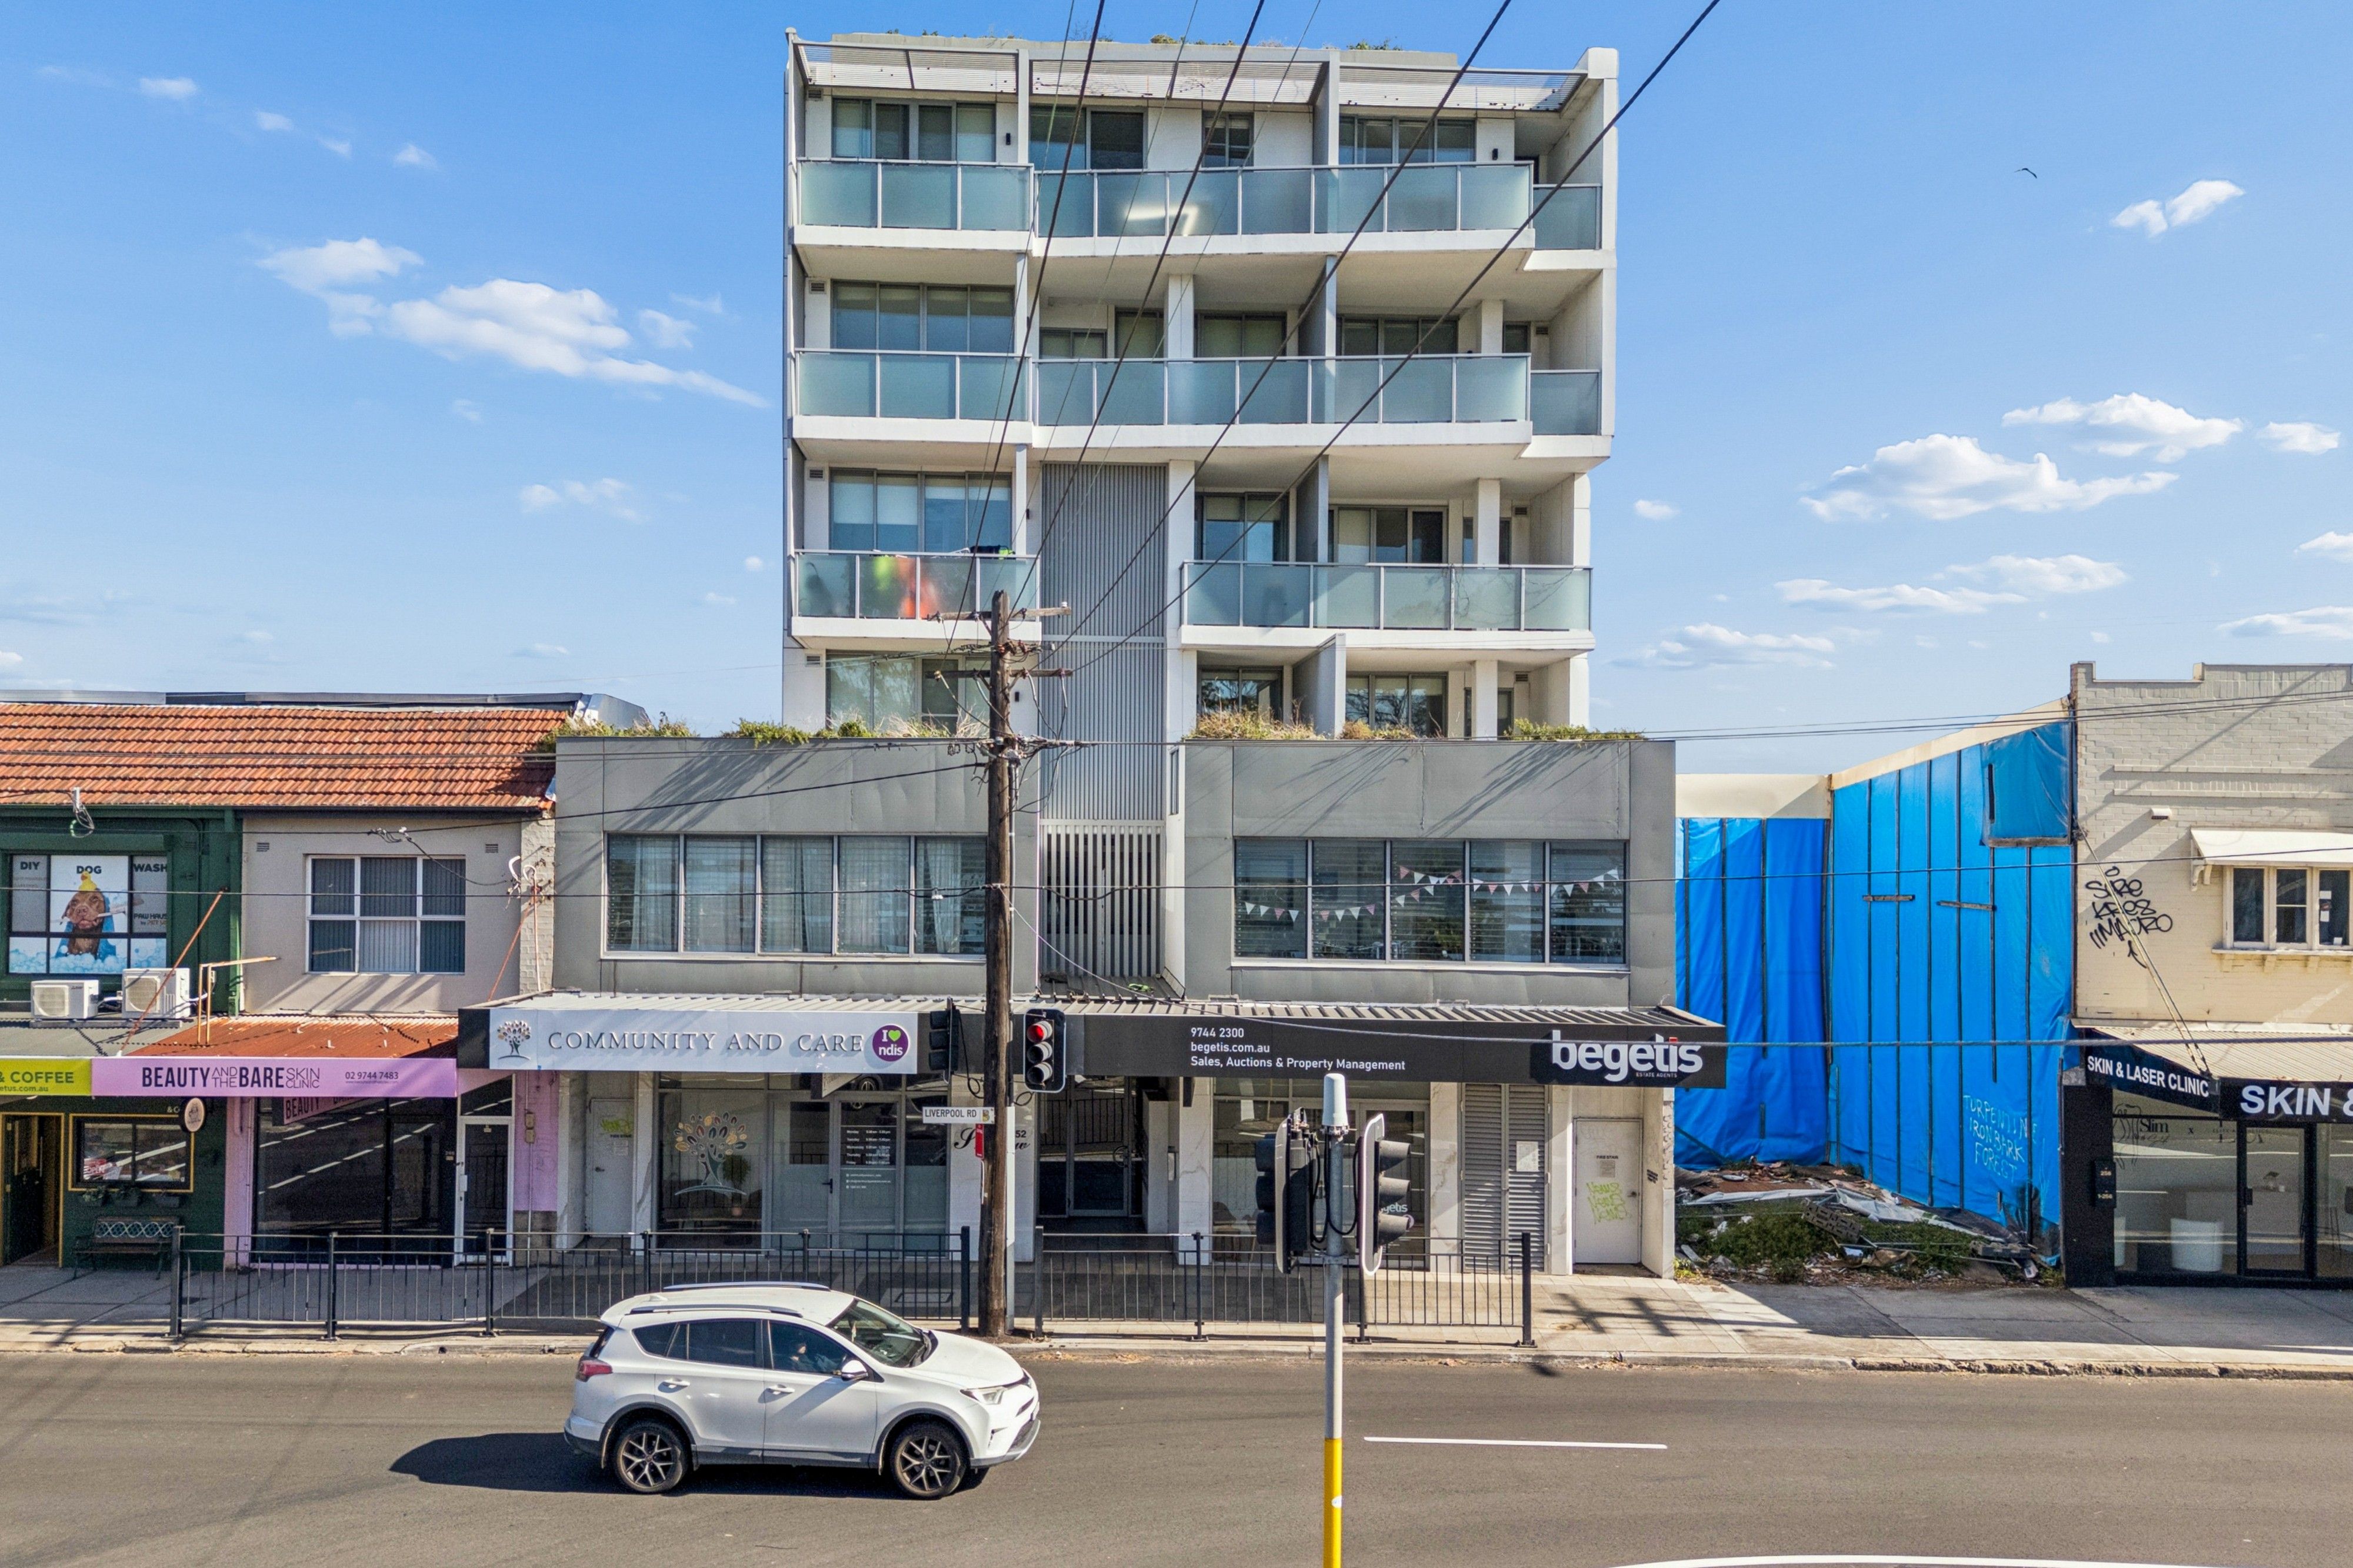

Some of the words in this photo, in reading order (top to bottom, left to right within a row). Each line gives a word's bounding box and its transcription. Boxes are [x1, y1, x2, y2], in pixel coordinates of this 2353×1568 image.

[20, 861, 41, 870] DIY
[76, 865, 102, 874] DOG
[134, 863, 167, 872] WASH
[882, 1030, 888, 1042] I
[1191, 1027, 1217, 1037] 9744
[1219, 1027, 1244, 1037] 2300
[548, 1032, 716, 1050] COMMUNITY
[726, 1033, 784, 1051] AND
[797, 1033, 864, 1052] CARE
[1191, 1042, 1271, 1054] begetis.com.au
[878, 1043, 903, 1056] ndis
[1552, 1029, 1704, 1082] begetis
[1191, 1056, 1224, 1068] Sales,
[1226, 1057, 1273, 1067] Auctions
[1275, 1058, 1284, 1067] &
[1287, 1058, 1334, 1070] Property
[1336, 1059, 1406, 1070] Management
[10, 1071, 74, 1083] COFFEE
[142, 1066, 211, 1087] BEAUTY
[211, 1066, 238, 1077] AND
[239, 1066, 285, 1088] BARE
[286, 1067, 320, 1079] SKIN
[2088, 1056, 2114, 1076] SKIN
[2116, 1061, 2124, 1078] &
[2127, 1064, 2166, 1088] LASER
[2168, 1073, 2209, 1098] CLINIC
[212, 1077, 238, 1087] THE
[286, 1079, 320, 1089] CLINIC
[2240, 1085, 2331, 1116] SKIN
[925, 1109, 964, 1117] LIVERPOOL
[966, 1109, 976, 1117] RD
[2140, 1118, 2168, 1132] Slim
[1381, 1202, 1408, 1214] getis
